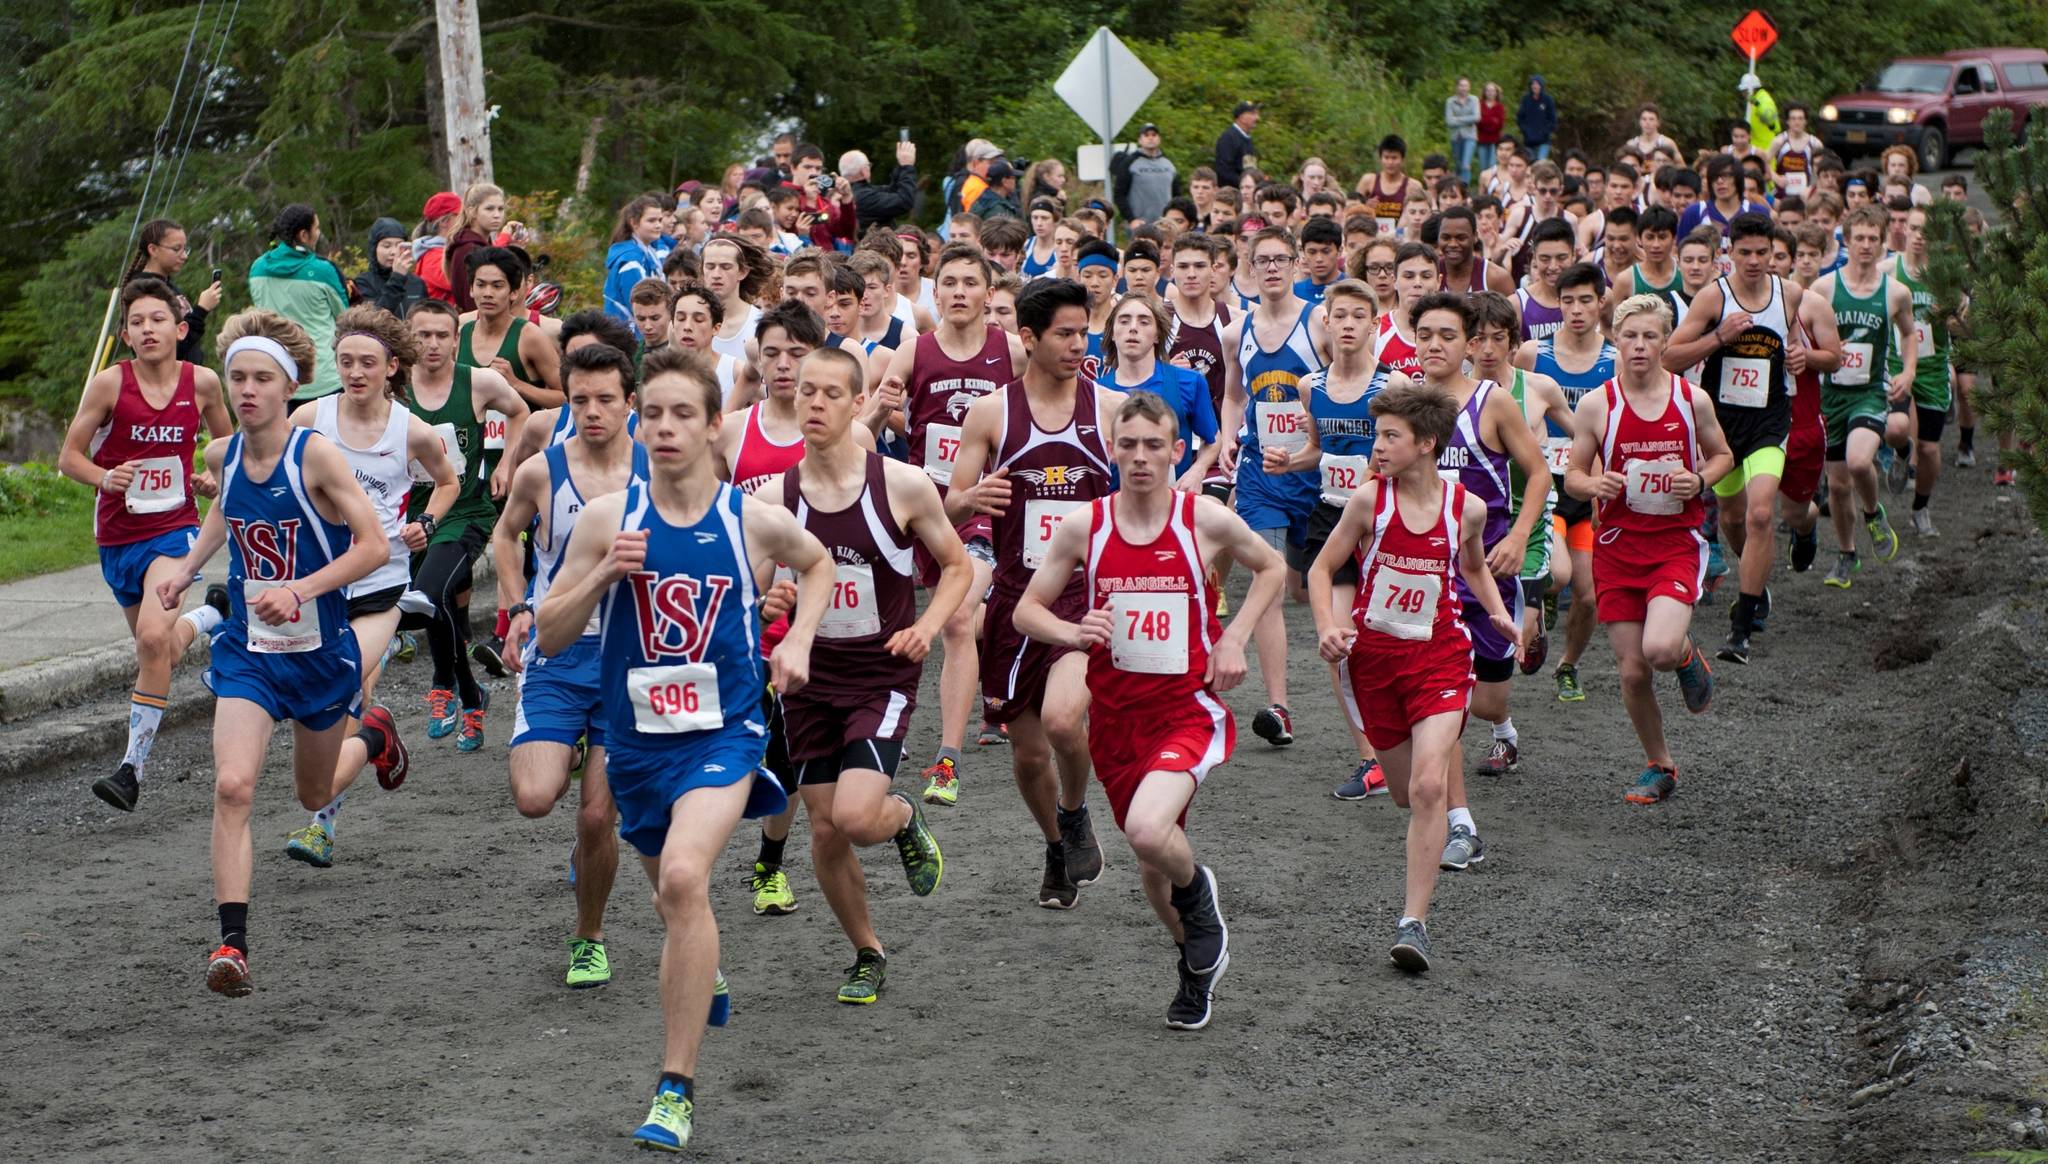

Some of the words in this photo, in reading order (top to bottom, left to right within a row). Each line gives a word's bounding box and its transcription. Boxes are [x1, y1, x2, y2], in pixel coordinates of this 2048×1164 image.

[1738, 27, 1769, 43] SLOW
[1834, 310, 1882, 330] HAINES
[929, 379, 962, 394] KAYHI
[964, 378, 997, 393] KINGS
[1732, 367, 1759, 388] 752
[130, 424, 185, 443] KAKE
[1266, 413, 1297, 434] 705
[1620, 440, 1685, 455] WRANGELL
[138, 468, 172, 492] 756
[1327, 466, 1358, 490] 732
[1640, 472, 1673, 494] 750
[836, 545, 867, 568] KINGS
[1376, 550, 1447, 572] WRANGELL
[832, 580, 860, 610] 76
[1097, 576, 1189, 592] WRANGELL
[1384, 583, 1426, 614] 749
[1126, 610, 1171, 641] 748
[648, 681, 699, 716] 696
